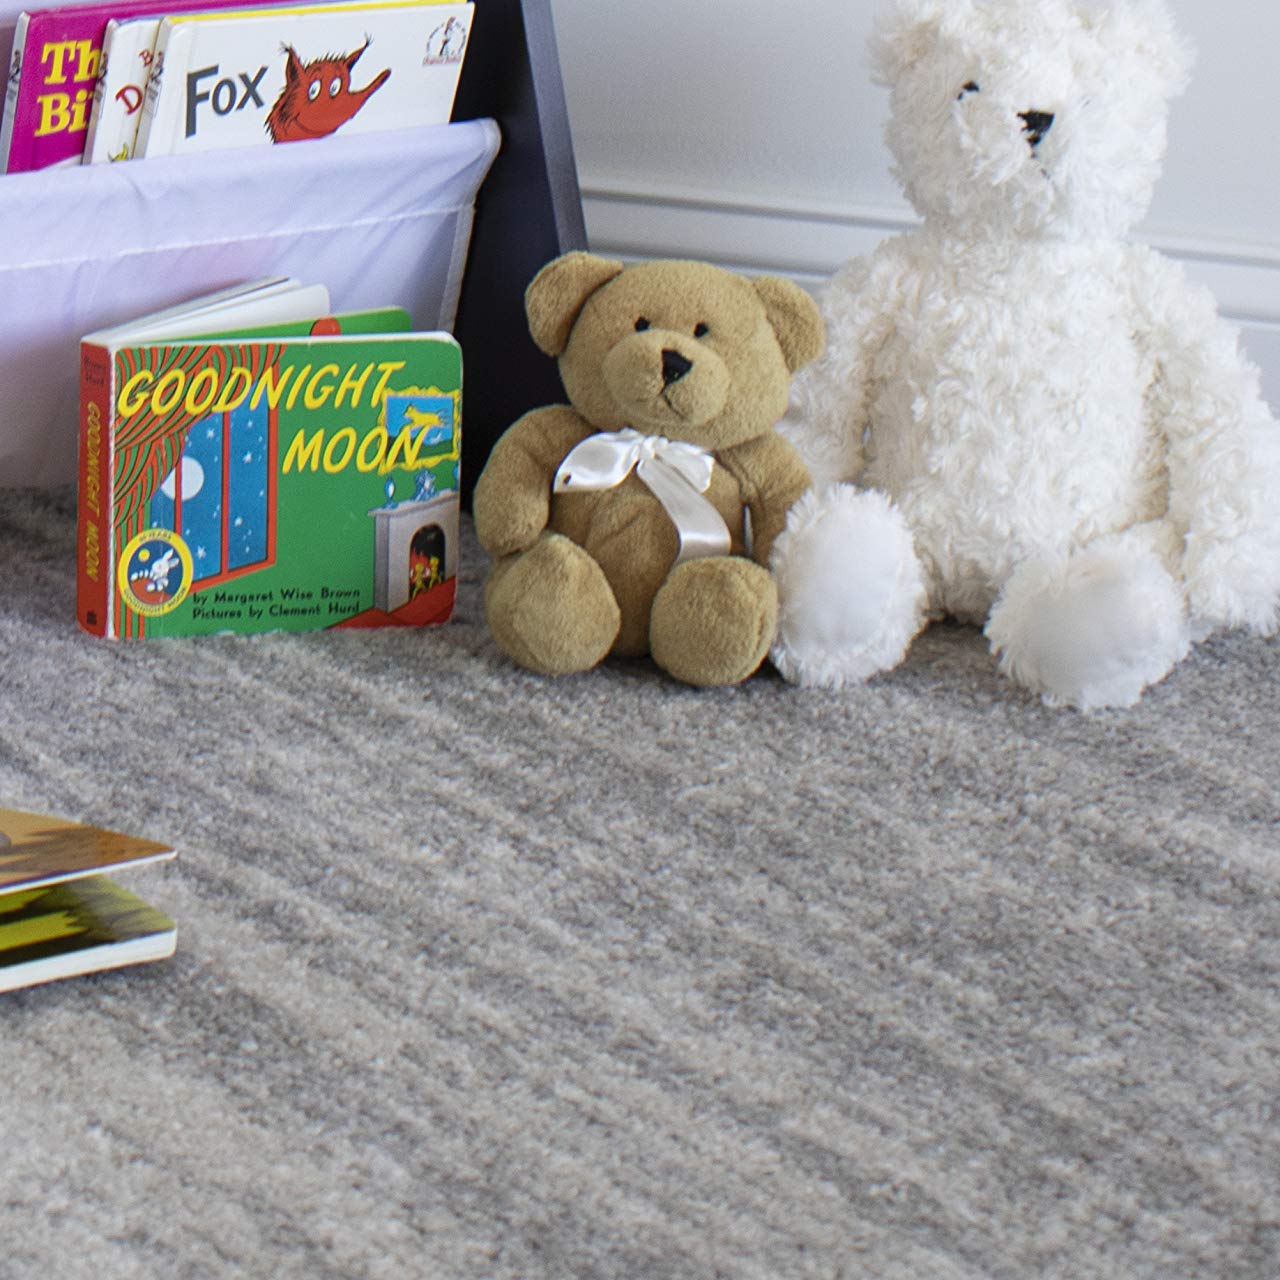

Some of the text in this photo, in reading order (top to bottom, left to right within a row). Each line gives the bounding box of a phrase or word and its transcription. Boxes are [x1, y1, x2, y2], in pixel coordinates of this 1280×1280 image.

[185, 64, 269, 139] Fox
[117, 360, 407, 418] GOODNIGHT
[282, 424, 430, 475] MOON
[192, 585, 360, 606] by Margaret Wise Brown
[192, 601, 360, 620] Pictures by Clement Hurd
